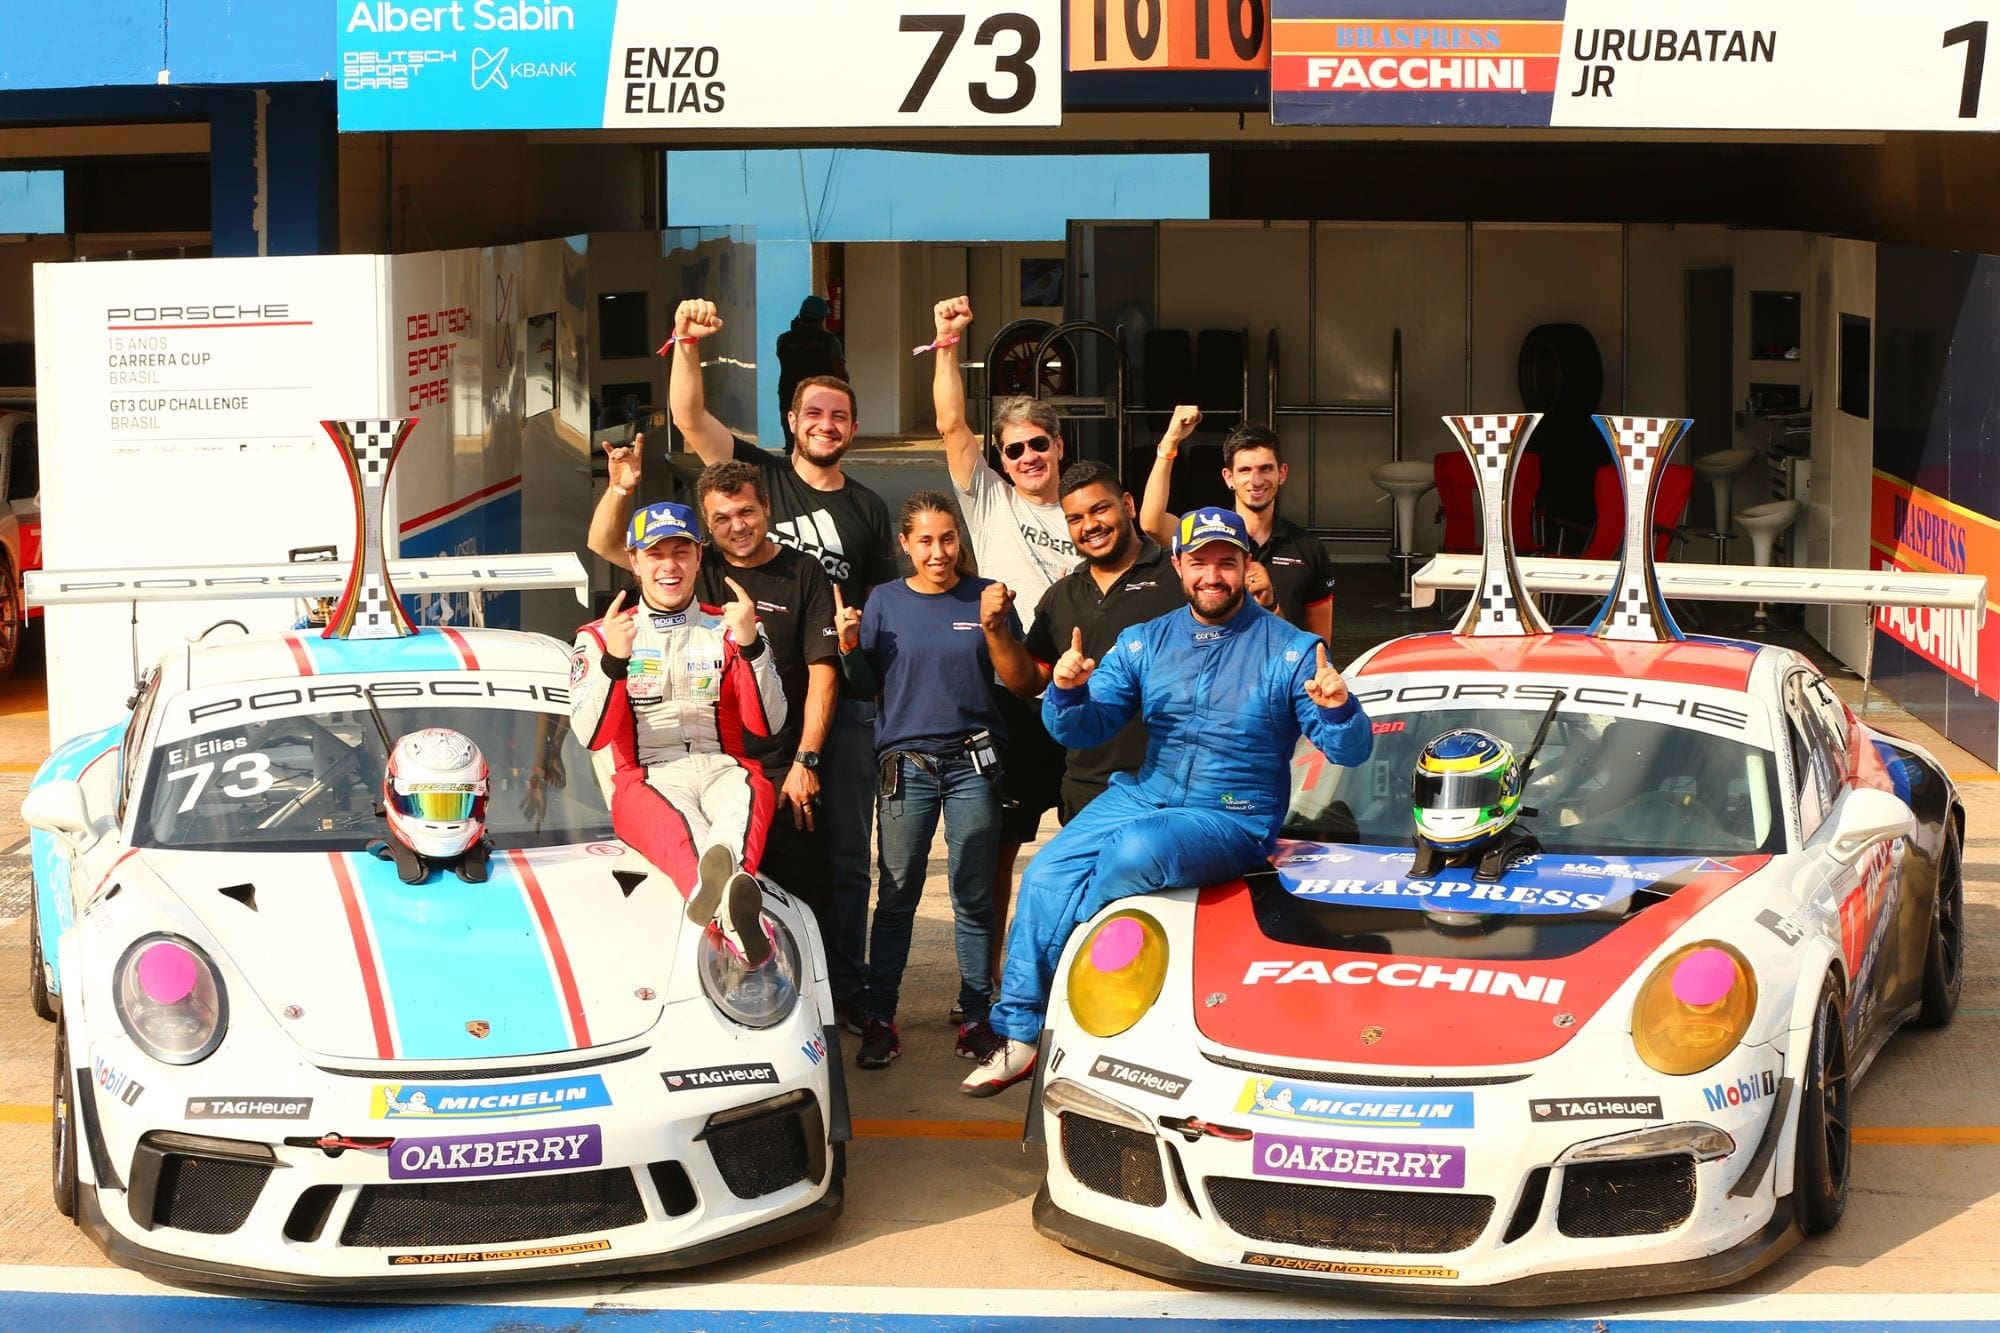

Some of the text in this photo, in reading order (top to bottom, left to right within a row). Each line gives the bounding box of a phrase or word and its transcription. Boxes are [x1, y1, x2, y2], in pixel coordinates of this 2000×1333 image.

[346, 0, 574, 33] Albert Sabin
[1336, 26, 1502, 50] BRASPRESS
[1573, 28, 1777, 62] URUBATAN
[344, 50, 458, 64] DEUTSCH
[344, 64, 424, 77] SPORT
[510, 61, 577, 78] KBANK
[624, 46, 719, 79] ENZO
[897, 12, 1041, 114] 73
[1307, 58, 1524, 89] FACCHINI
[1942, 20, 1989, 119] 1
[344, 77, 409, 90] CARS
[625, 81, 727, 114] ELIAS
[1571, 64, 1616, 98] JR
[107, 304, 289, 322] PORSCHE
[407, 307, 472, 341] DEUTSCH
[108, 352, 211, 368] CARRERA CUP
[127, 336, 168, 351] ANOS
[408, 343, 457, 377] SPORT
[109, 370, 161, 385] BRASIL
[110, 396, 249, 412] GT3 CUP CHALLENGE
[408, 378, 449, 412] CARS
[110, 416, 161, 430] BRASIL
[1893, 495, 1967, 574] BRASPRESS
[194, 734, 249, 757] Elias
[167, 752, 274, 815] 73
[1291, 878, 1607, 911] BRASPRESS
[1241, 960, 1568, 1005] FACCHINI
[95, 1055, 125, 1097] Mobil
[1702, 1070, 1773, 1112] Mobil 1
[438, 1087, 587, 1109] MICHELIN
[1299, 1098, 1455, 1120] MICHELIN
[400, 1133, 589, 1172] OAKBERRY
[1264, 1142, 1453, 1180] OAKBERRY
[420, 1240, 605, 1265] DENER MOTORSPORT
[1270, 1257, 1455, 1278] DENER MOTORSPORT
